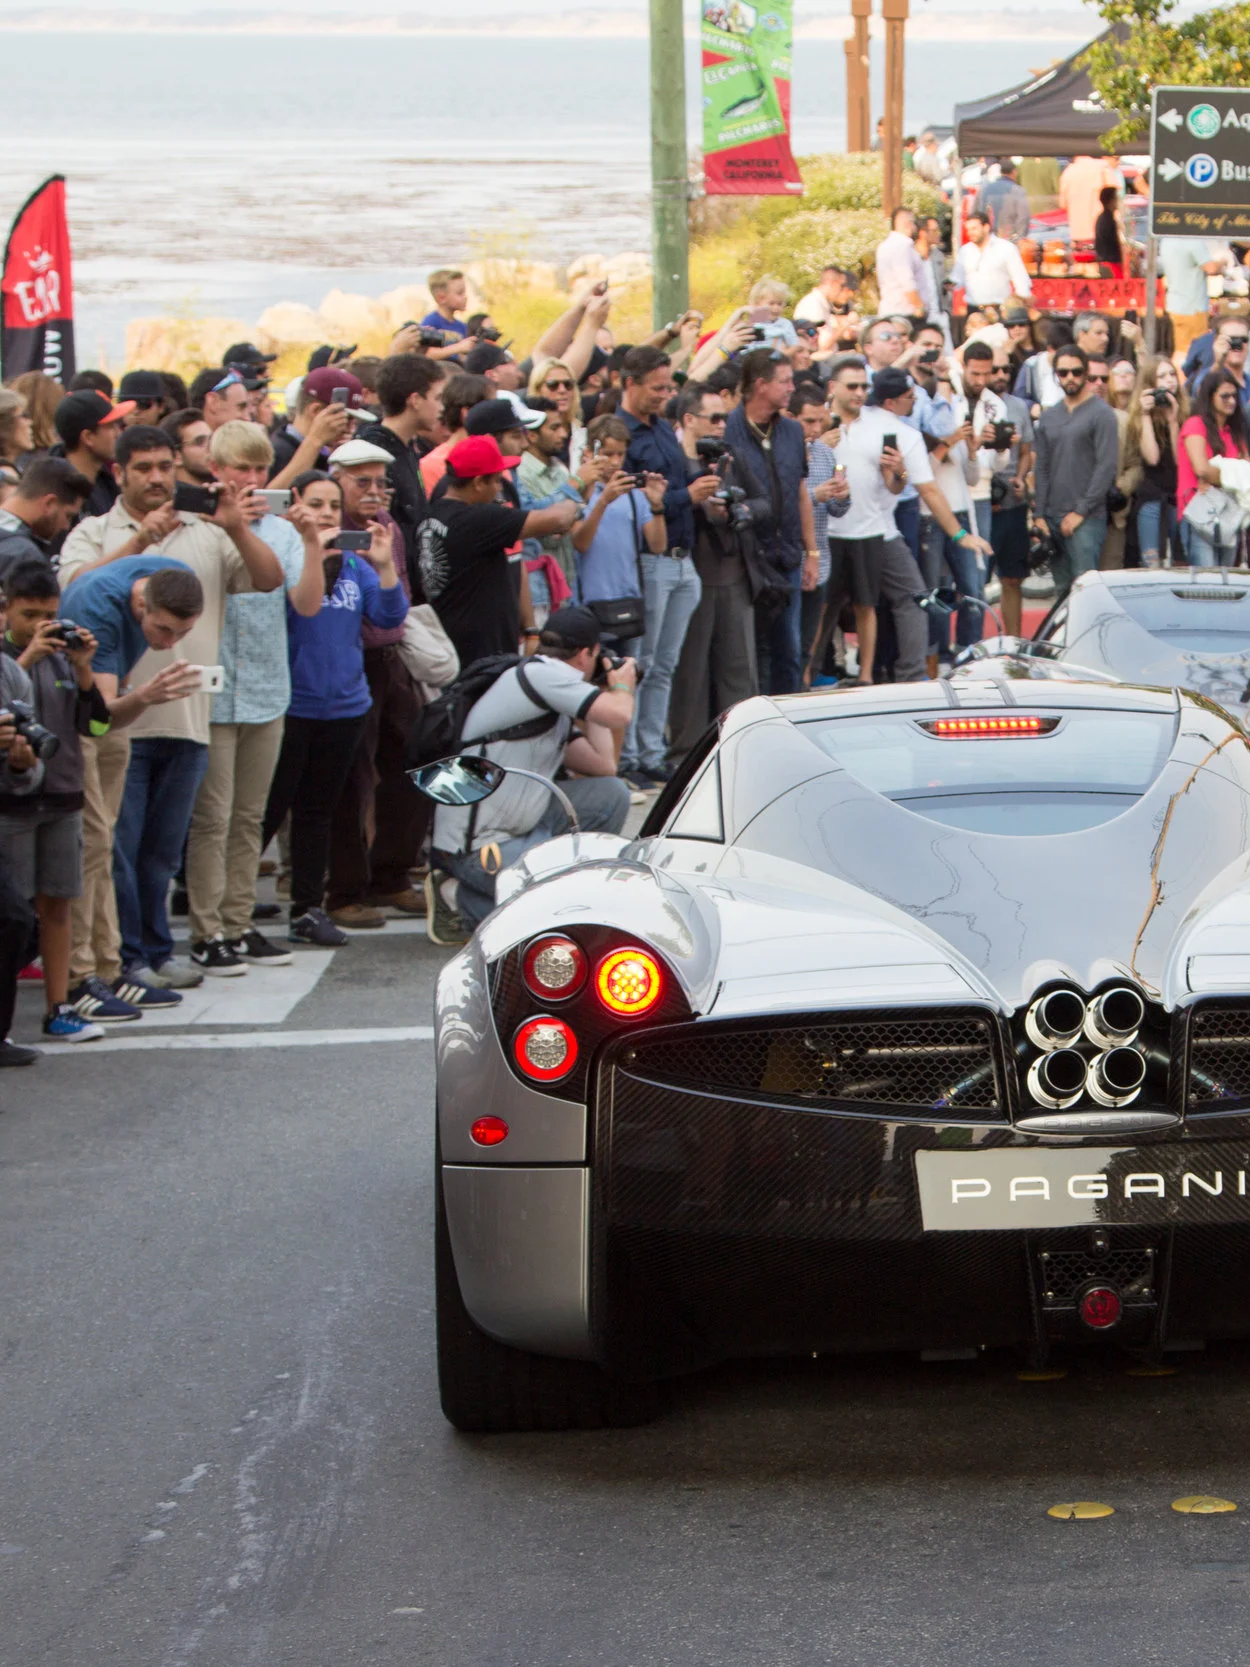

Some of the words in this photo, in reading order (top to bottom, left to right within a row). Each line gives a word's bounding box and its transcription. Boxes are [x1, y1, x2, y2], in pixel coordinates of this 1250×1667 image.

[725, 158, 780, 168] MONTEREY
[1194, 160, 1212, 182] P
[722, 170, 784, 179] CALIFORNIA
[1156, 212, 1181, 225] The
[1184, 212, 1210, 231] City
[1212, 213, 1228, 231] of
[951, 1171, 1246, 1204] PAGANI
